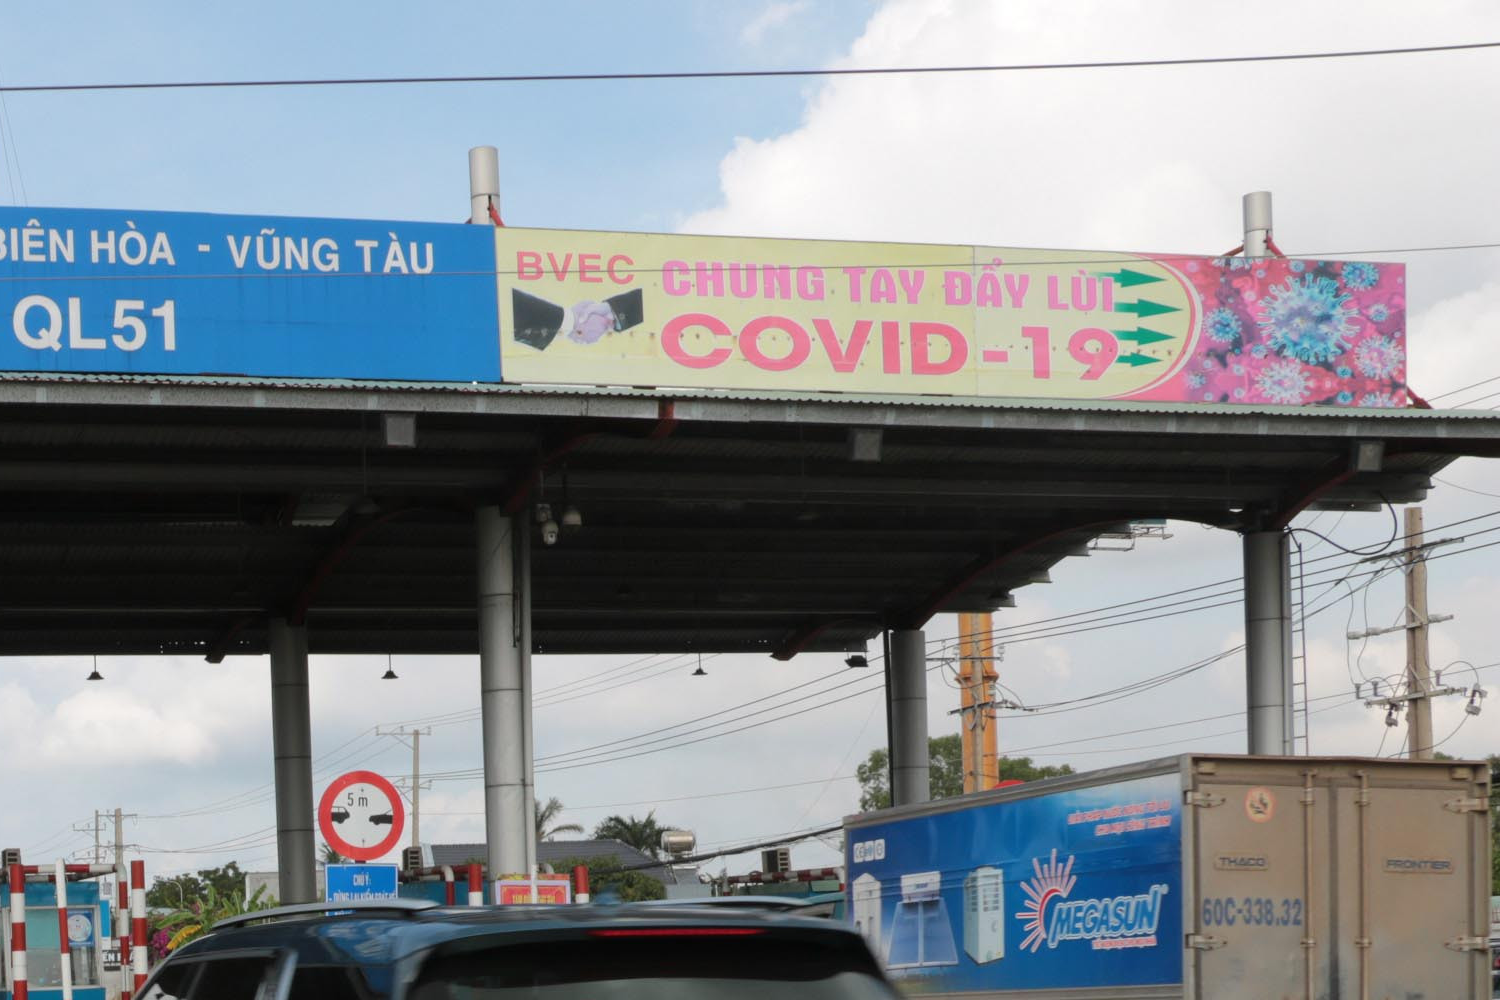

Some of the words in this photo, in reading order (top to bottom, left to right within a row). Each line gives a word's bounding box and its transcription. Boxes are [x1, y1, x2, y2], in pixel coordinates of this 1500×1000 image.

[91, 220, 176, 266] HÒA
[227, 228, 340, 272] VŨNG
[356, 232, 434, 275] TÀU
[516, 251, 636, 285] BVEC
[661, 260, 826, 301] CHUNG
[842, 266, 925, 305] TAY
[941, 257, 1030, 309] ĐẨY
[1047, 269, 1114, 312] LÙI
[13, 294, 176, 352] QL51
[347, 792, 354, 807] 5
[358, 796, 368, 807] m
[1218, 856, 1266, 867] THACO
[1386, 858, 1451, 870] FRONTIER
[1047, 884, 1161, 948] MEGASUN
[1202, 897, 1303, 926] 60C-338.32
